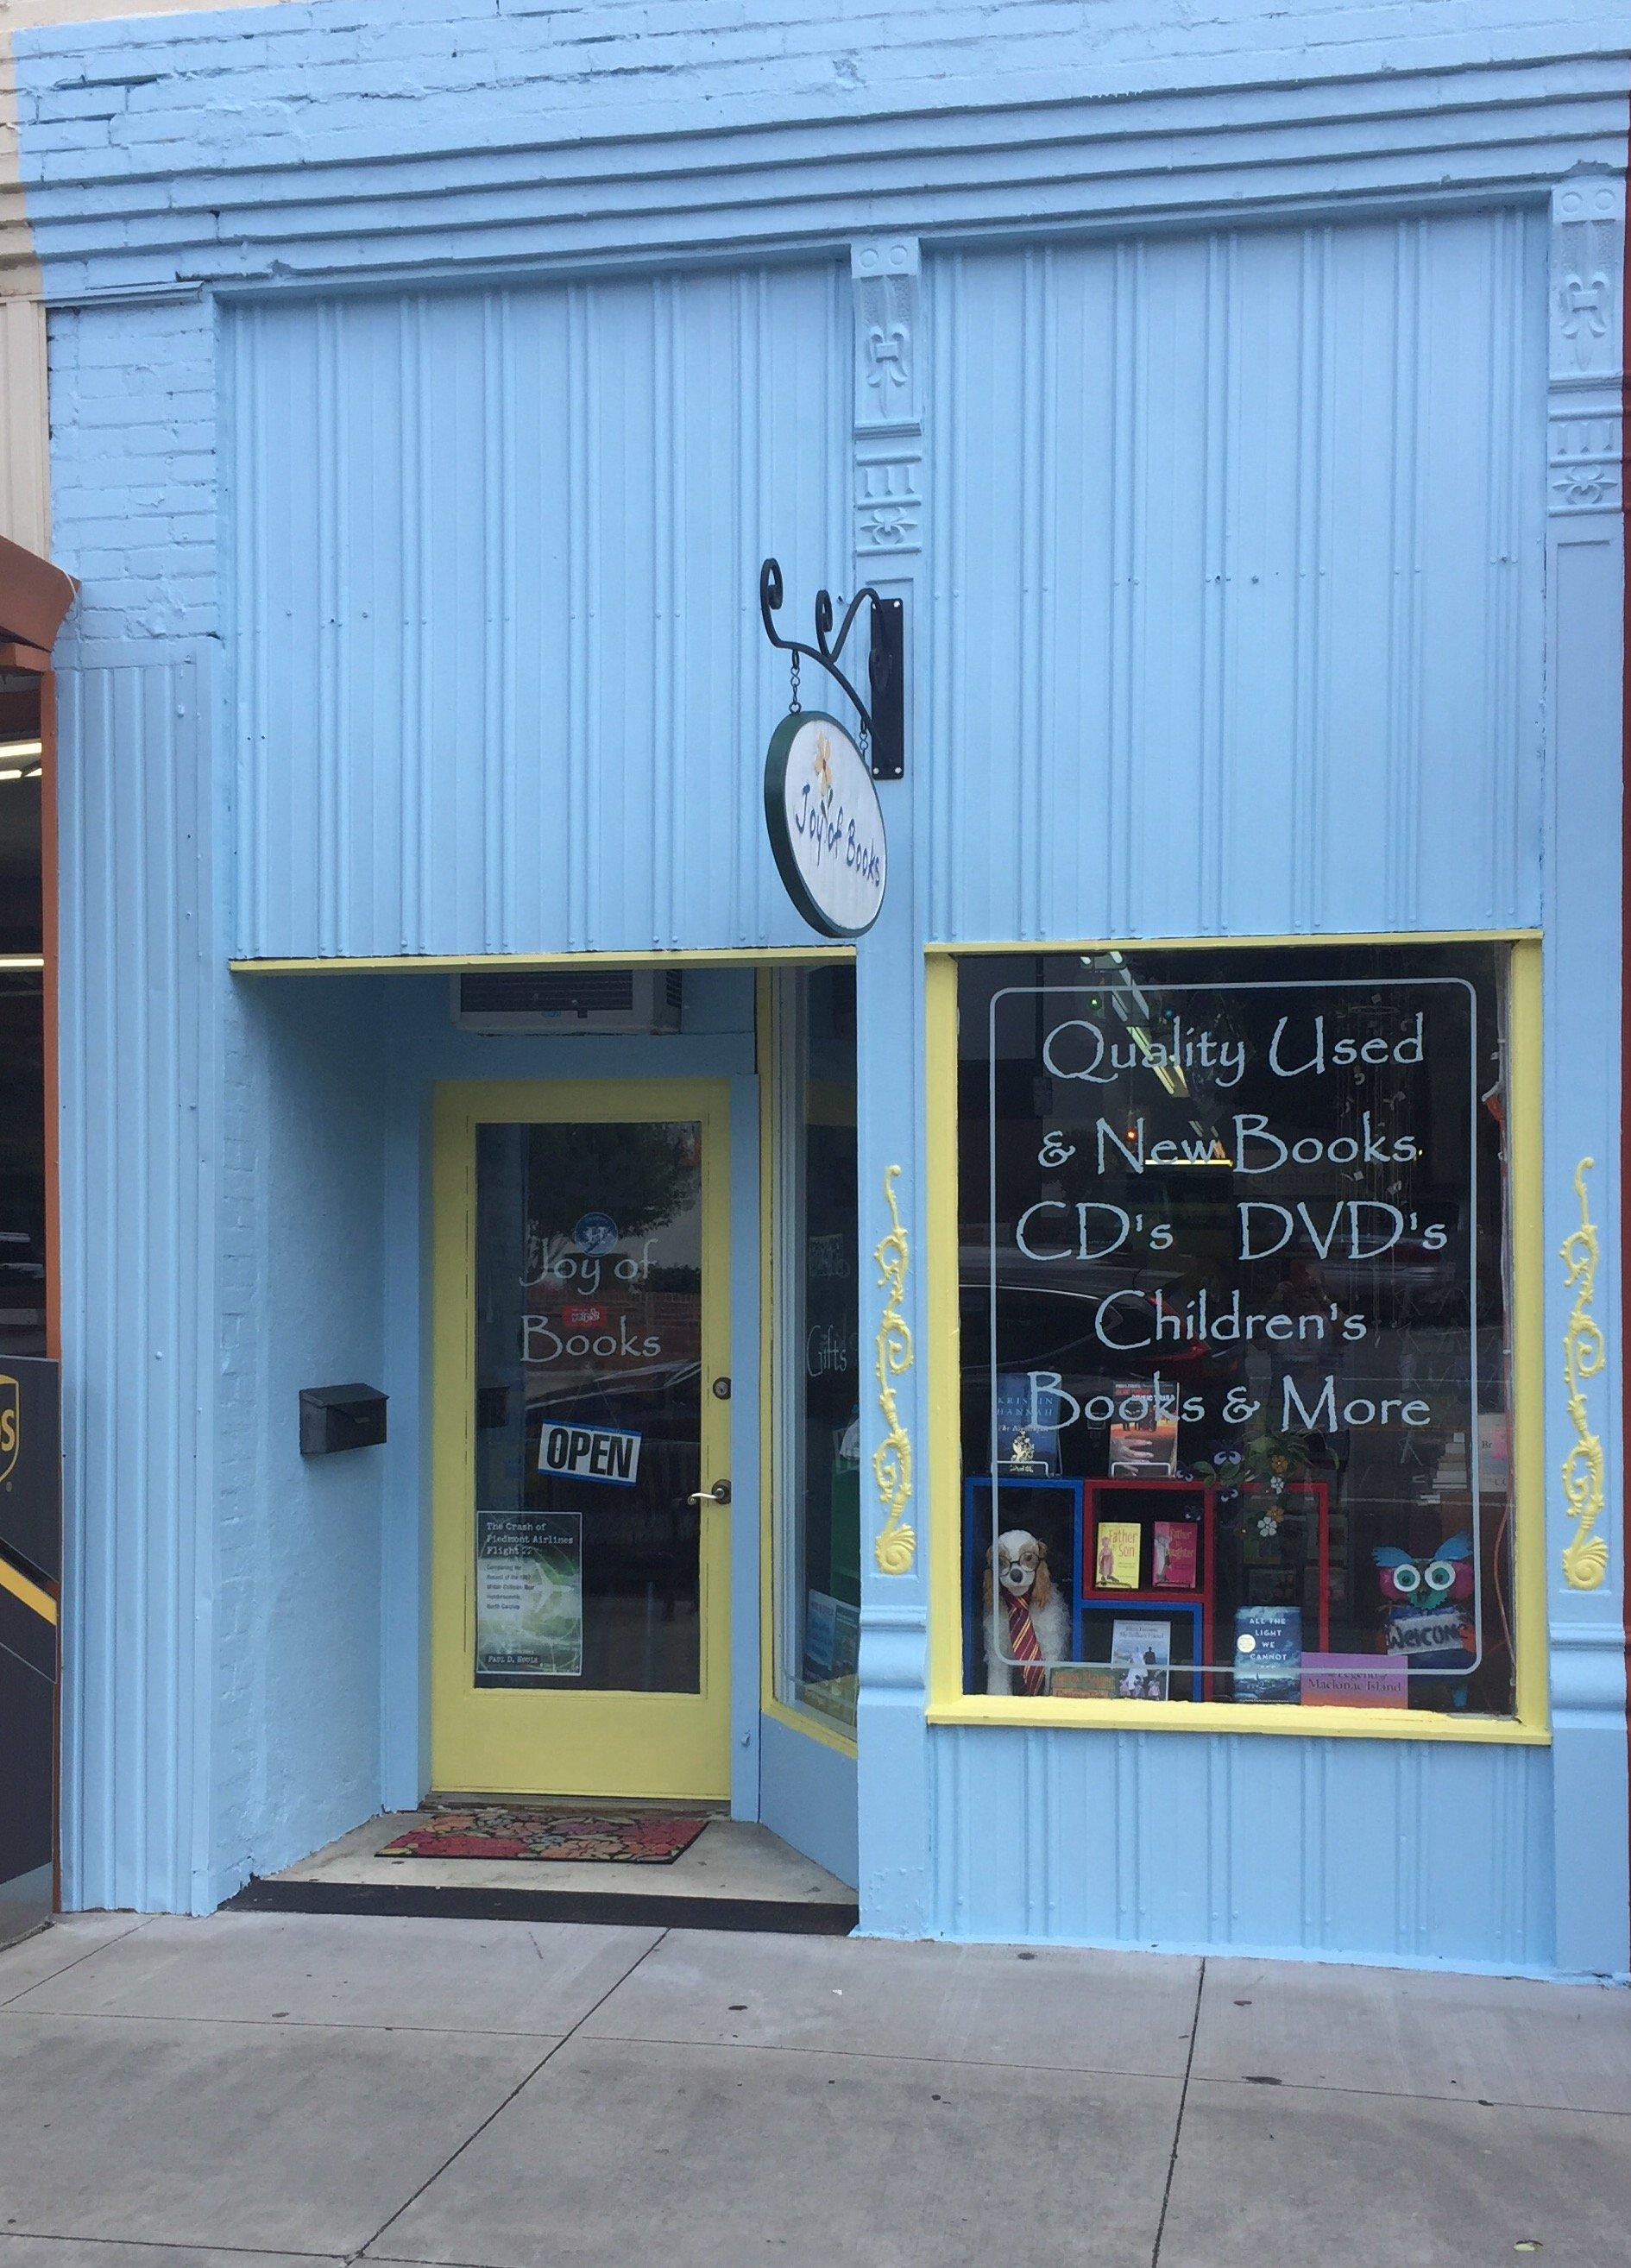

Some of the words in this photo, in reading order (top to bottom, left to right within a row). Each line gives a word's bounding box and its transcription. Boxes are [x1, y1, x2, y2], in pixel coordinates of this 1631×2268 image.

[795, 784, 824, 866] Joy
[828, 806, 843, 859] of
[846, 818, 880, 887] Books
[1042, 1016, 1245, 1087] Quality
[1269, 1012, 1425, 1078] Used
[1038, 1130, 1075, 1168] &
[1096, 1118, 1222, 1174] New
[1232, 1112, 1417, 1174] Books
[1016, 1201, 1174, 1260] CD's
[1238, 1201, 1447, 1260] DVD's
[519, 1238, 601, 1295] Joy
[614, 1238, 659, 1281] of
[520, 1315, 662, 1363] Books
[1094, 1290, 1366, 1350] Children's
[807, 1324, 847, 1377] Gifts
[1027, 1371, 1205, 1430] Books
[1222, 1387, 1261, 1422] &
[1281, 1375, 1431, 1432] More
[547, 1428, 633, 1478] OPEN
[486, 1534, 530, 1544] Piedmont
[532, 1535, 574, 1544] Airlines
[487, 1522, 503, 1531] The
[506, 1522, 533, 1531] Crash
[535, 1522, 546, 1531] of
[487, 1546, 520, 1556] Flight
[1109, 1529, 1138, 1543] Father
[1118, 1545, 1135, 1558] Son
[1308, 1679, 1362, 1692] Mackinac
[1367, 1680, 1401, 1692] Island
